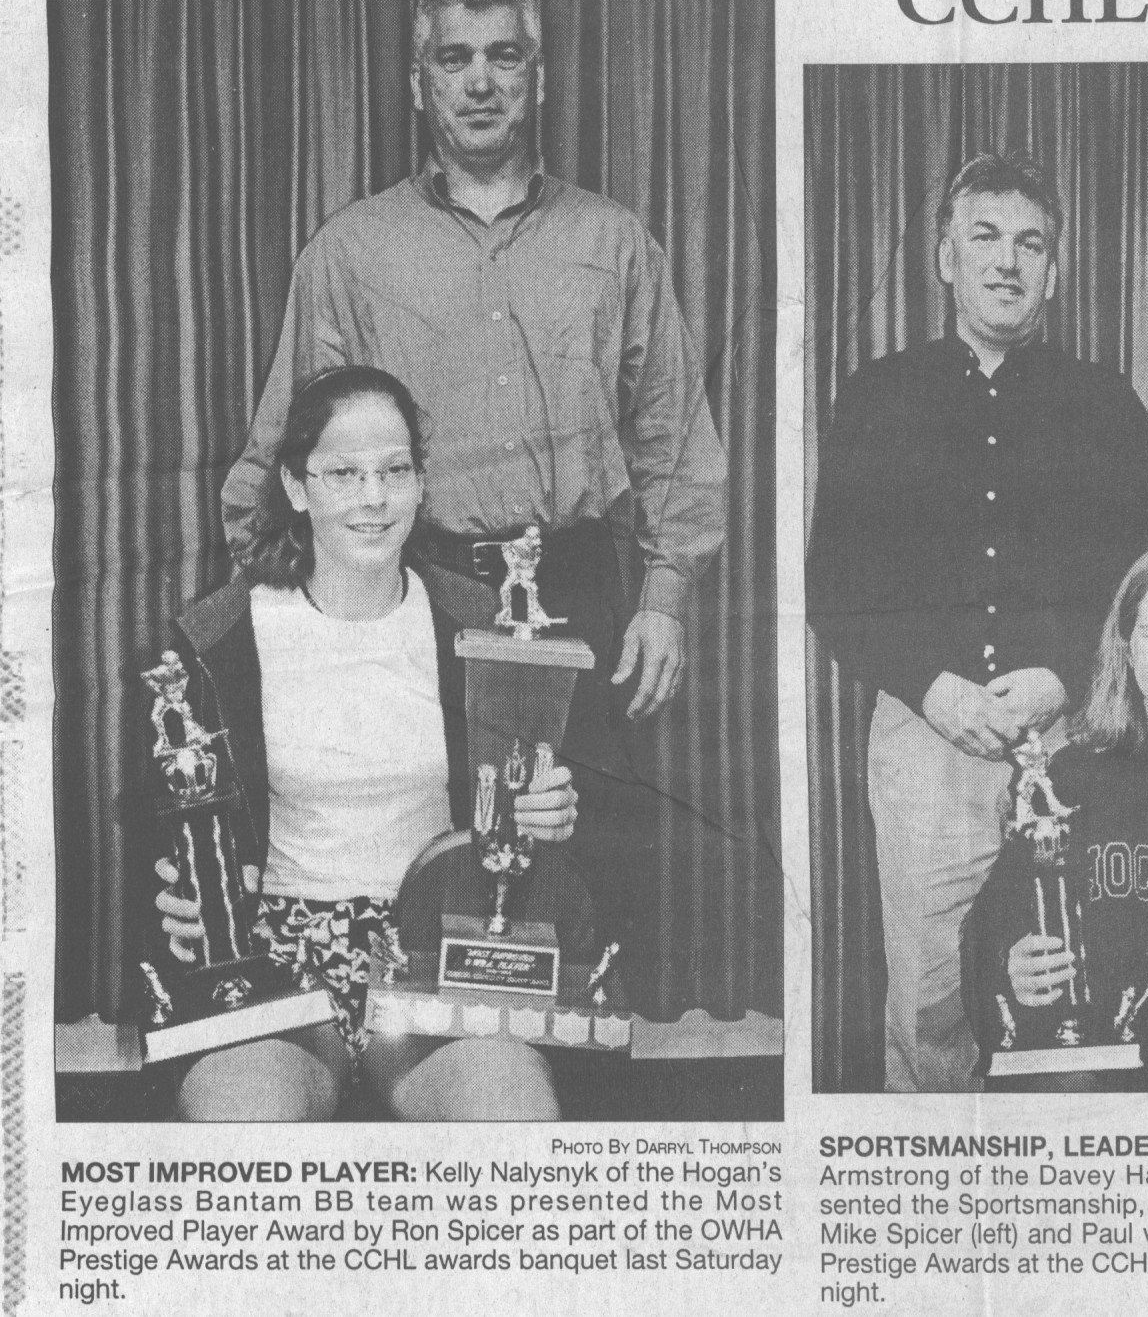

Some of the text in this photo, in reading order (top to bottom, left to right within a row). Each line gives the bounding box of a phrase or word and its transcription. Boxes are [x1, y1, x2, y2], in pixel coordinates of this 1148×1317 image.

[552, 1138, 781, 1155] PHOTO BY DARRYL THOMPSON
[819, 1135, 1053, 1161] SPORTSMANSHIP,
[62, 1161, 782, 1188] MOST IMPROVED PLAYER: Kelly Nalysnyk of the Hogan's
[819, 1165, 949, 1191] Armstrong
[960, 1164, 981, 1186] of
[991, 1165, 1028, 1186] the
[1040, 1164, 1115, 1191] Davey
[62, 1190, 782, 1217] Eyeglass Bantam BB team was presented the Most
[60, 1278, 125, 1305] night.
[821, 1281, 885, 1308] night.
